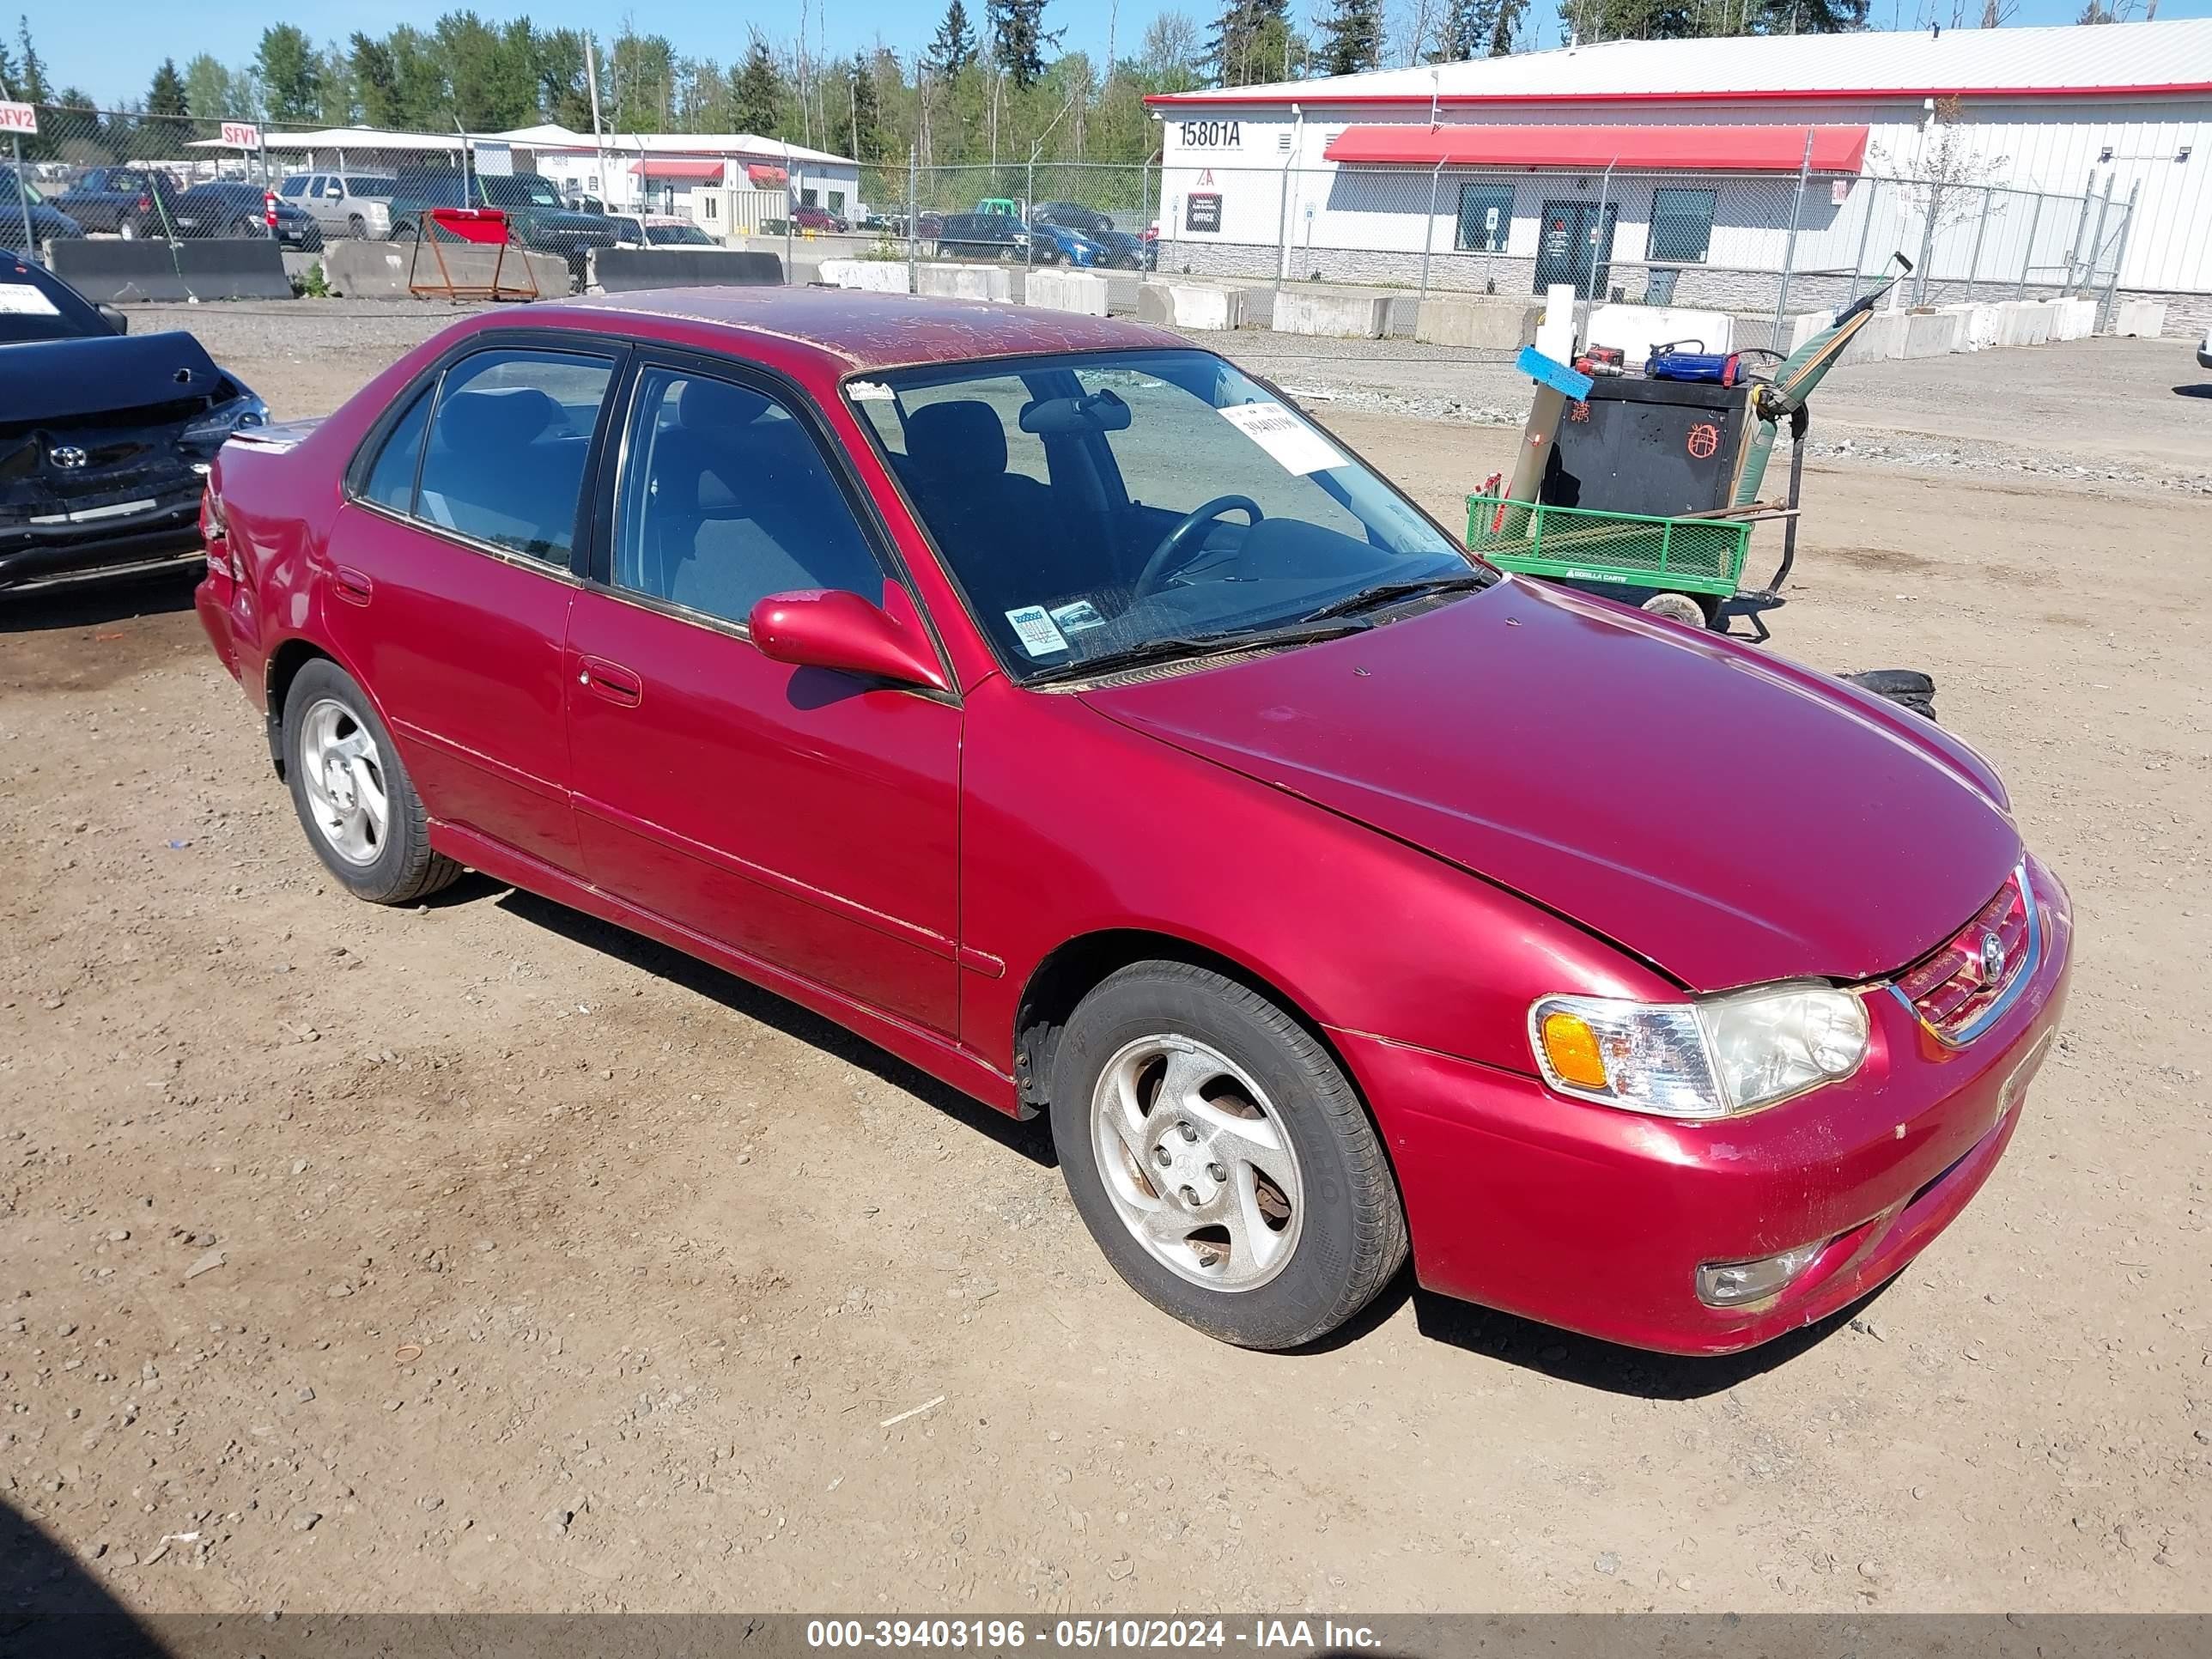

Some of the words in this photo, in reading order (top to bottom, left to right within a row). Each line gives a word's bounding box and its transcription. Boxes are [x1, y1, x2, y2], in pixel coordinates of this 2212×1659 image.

[224, 126, 255, 145] SFV1
[1179, 121, 1240, 146] 15801A
[1193, 212, 1214, 222] OFFICE
[1574, 571, 1602, 580] GORILLA
